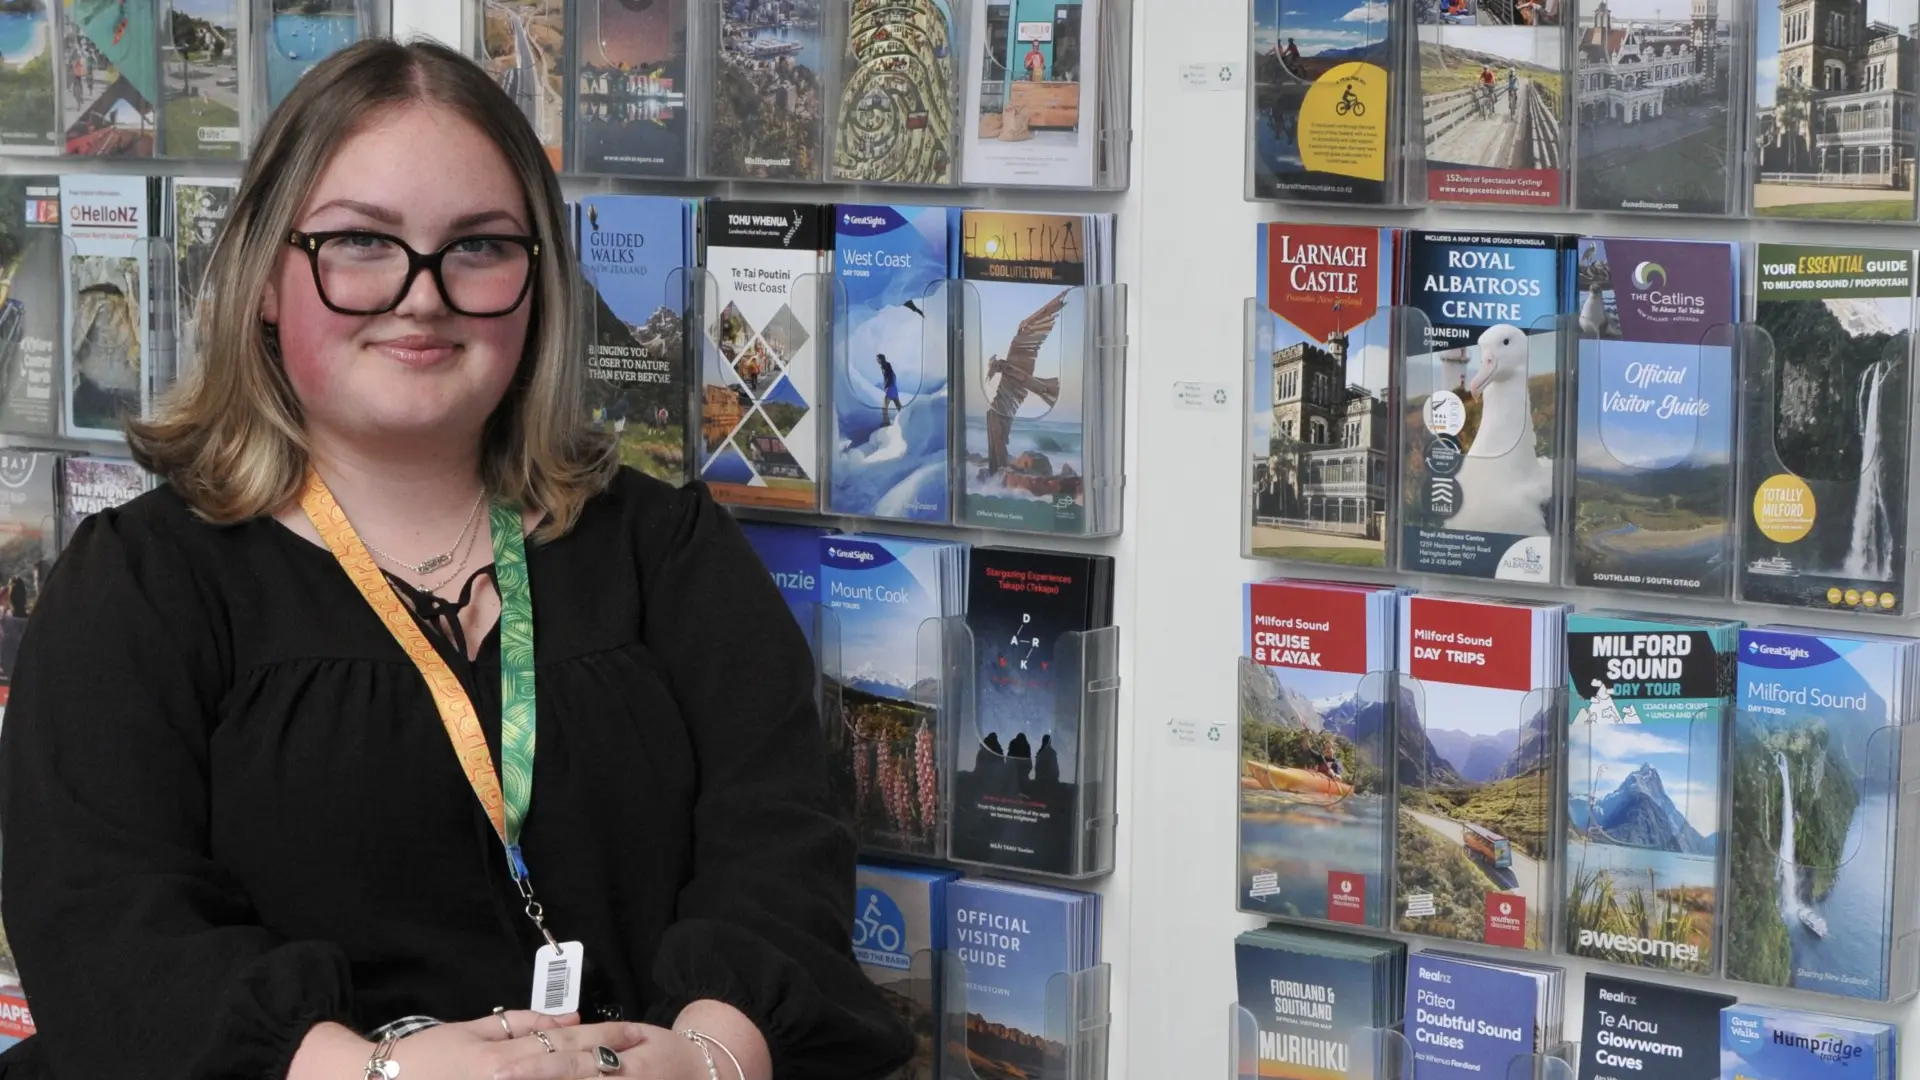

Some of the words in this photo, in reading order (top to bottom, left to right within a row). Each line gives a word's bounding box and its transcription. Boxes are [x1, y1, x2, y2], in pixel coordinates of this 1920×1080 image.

[1481, 176, 1516, 186] Spectacular
[1517, 178, 1543, 188] Cycling!
[81, 205, 138, 222] HelloNZ
[728, 214, 751, 226] TOHU
[752, 216, 788, 227] WHENUA
[850, 215, 886, 228] GreatSights
[590, 231, 644, 248] GUIDED
[1424, 234, 1451, 242] INCLUDES
[1513, 238, 1545, 246] PENINSULA
[591, 248, 635, 263] WALKS
[843, 248, 873, 265] West
[875, 249, 912, 268] Coast
[1281, 235, 1367, 267] LARNACH
[1448, 250, 1515, 270] ROYAL
[1762, 263, 1796, 275] YOUR
[1798, 255, 1864, 275] ESSENTIAL
[1866, 260, 1908, 273] GUIDE
[590, 264, 607, 273] NEW
[610, 265, 647, 275] ZEALAND
[731, 268, 741, 278] Te
[744, 268, 756, 278] Tai
[758, 269, 791, 279] Poutini
[1290, 264, 1358, 293] CASTLE
[1423, 274, 1541, 297] ALBATROSS
[1762, 281, 1774, 290] TO
[1775, 280, 1814, 290] MILFORD
[1815, 279, 1848, 289] SOUND
[1854, 278, 1909, 287] PIOPIOTAHI
[734, 282, 757, 292] West
[759, 282, 787, 293] Coast
[1630, 293, 1648, 301] THE
[1650, 291, 1705, 306] Catlins
[1442, 300, 1521, 321] CENTRE
[1423, 326, 1470, 339] DUNEDIN
[630, 347, 648, 357] YOU
[622, 359, 634, 369] TO
[635, 360, 670, 371] NATURE
[589, 369, 613, 380] THAN
[614, 370, 637, 381] EVER
[638, 372, 671, 383] BEFORE
[1624, 361, 1687, 389] Official
[1602, 390, 1655, 413] Visitor
[1656, 394, 1710, 420] Guide
[71, 482, 90, 495] The
[1763, 488, 1804, 502] TOTALLY
[1762, 503, 1804, 517] MILFORD
[1419, 530, 1436, 538] Royal
[1436, 531, 1464, 541] Albatross
[1465, 534, 1485, 542] Centre
[836, 549, 874, 563] GreatSights
[1447, 551, 1461, 559] Point
[1461, 543, 1476, 551] Point
[1477, 545, 1491, 553] Road
[986, 567, 1026, 580] Stargazing
[1027, 571, 1072, 584] Experiences
[1593, 573, 1641, 583] SOUTHLAND
[1646, 577, 1673, 586] SOUTH
[1673, 579, 1700, 588] OTAGO
[831, 581, 873, 600] Mount
[876, 586, 908, 604] Cook
[1255, 615, 1293, 628] Milford
[1295, 618, 1329, 632] Sound
[1255, 631, 1310, 650] CRUISE
[1414, 629, 1454, 643] Milford
[1457, 633, 1492, 647] Sound
[1592, 634, 1692, 657] MILFORD
[1255, 648, 1266, 661] &
[1271, 649, 1321, 667] KAYAK
[1414, 646, 1441, 660] DAY
[1445, 650, 1486, 666] TRIPS
[1759, 644, 1809, 661] GreatSights
[1606, 657, 1683, 680] SOUND
[1613, 683, 1640, 696] DAY
[1644, 682, 1681, 696] TOUR
[1748, 681, 1806, 705] Milford
[1810, 688, 1867, 711] Sound
[1650, 711, 1675, 719] LUNCH
[1675, 711, 1692, 719] AND
[1748, 704, 1762, 712] DAY
[1762, 706, 1786, 715] TOURS
[1332, 893, 1360, 903] southern
[957, 908, 1031, 934] OFFICIAL
[1491, 915, 1520, 925] southern
[957, 928, 1020, 951] VISITOR
[1579, 929, 1689, 961] awesome
[871, 953, 883, 961] THE
[959, 947, 1006, 968] GUIDE
[1418, 967, 1452, 984] Realnz
[1797, 968, 1824, 981] Sharing
[1825, 971, 1839, 981] New
[1841, 974, 1869, 985] Zealand
[1270, 979, 1325, 1003] FIORDLAND
[1327, 987, 1335, 1004] &
[1417, 989, 1455, 1010] Pātea
[1599, 988, 1637, 1005] Realnz
[1275, 997, 1332, 1021] SOUTHLAND
[1275, 1016, 1299, 1025] OFFICIAL
[1299, 1020, 1320, 1028] VISITOR
[1416, 1008, 1475, 1033] Doubtful
[1477, 1020, 1521, 1042] Sound
[1599, 1010, 1615, 1027] Te
[1617, 1014, 1658, 1034] Anau
[1731, 1017, 1758, 1029] Great
[1415, 1028, 1464, 1050] Cruises
[1731, 1027, 1760, 1039] Walks
[1259, 1030, 1349, 1072] MURIHIKU
[1597, 1030, 1683, 1058] Glowworm
[1773, 1029, 1863, 1059] Humpridge
[1425, 1053, 1450, 1065] Whenua
[1450, 1058, 1481, 1071] Fiordland
[1595, 1049, 1643, 1071] Caves
[1820, 1053, 1841, 1062] track
